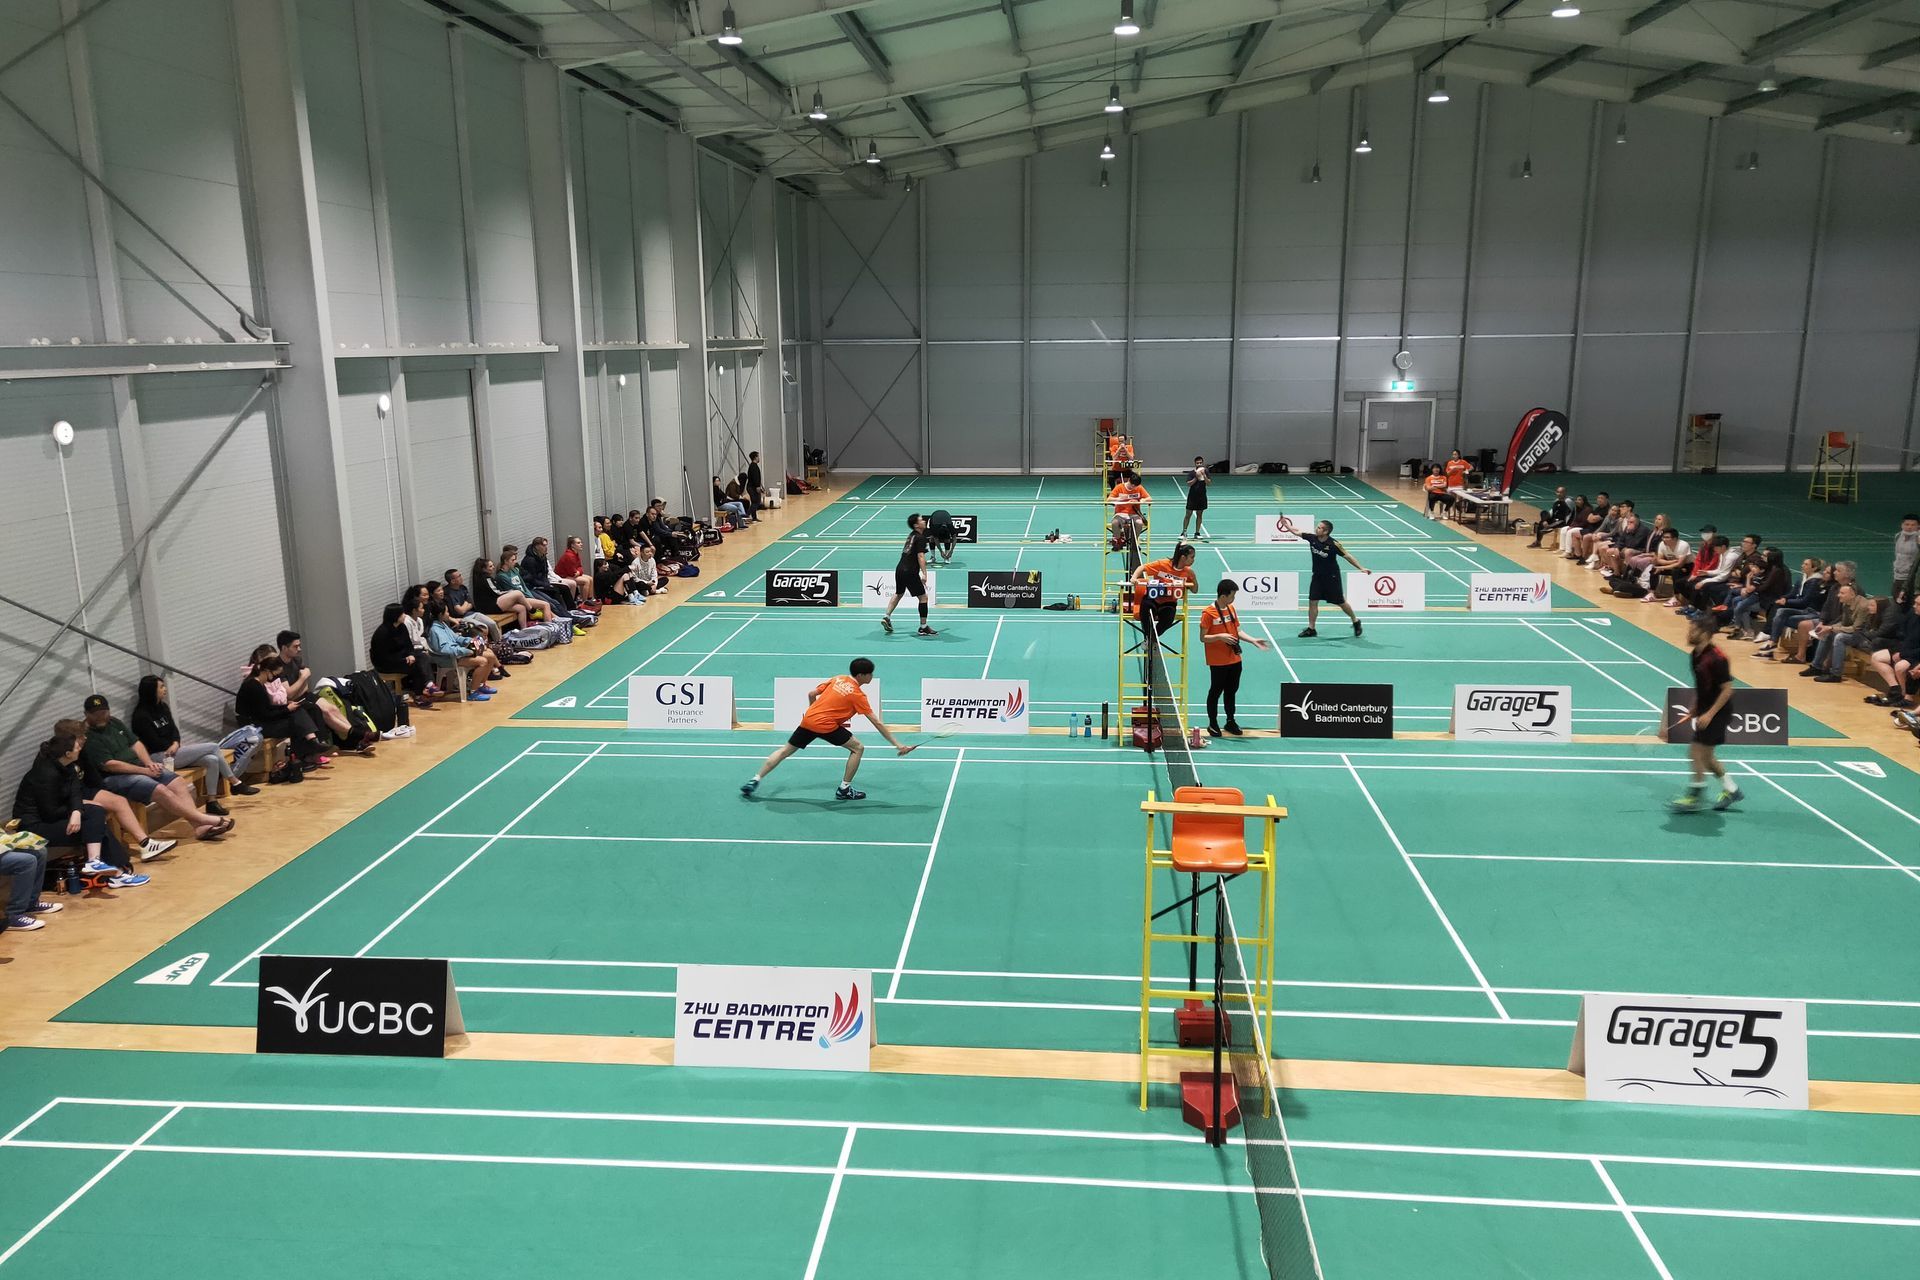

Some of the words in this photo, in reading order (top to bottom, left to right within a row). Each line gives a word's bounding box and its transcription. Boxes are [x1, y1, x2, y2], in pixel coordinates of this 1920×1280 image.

[1518, 420, 1563, 474] Garage5
[773, 573, 831, 598] Garage5
[1243, 576, 1278, 593] GSI
[1479, 593, 1528, 601] CENTRE
[655, 682, 704, 706] GSI
[926, 698, 946, 706] ZHU
[949, 699, 1006, 707] BADMINTON
[931, 707, 998, 719] CENTRE
[1311, 703, 1339, 712] United
[1340, 703, 1388, 714] Canterbury
[1315, 714, 1361, 723] Badminton
[1363, 715, 1383, 723] Club
[1466, 690, 1559, 727] Garage5
[1726, 713, 1781, 734] CBC
[165, 957, 202, 982] BWF
[319, 1001, 434, 1036] UCBC
[683, 1002, 720, 1015] ZHU
[725, 1003, 829, 1018] BADMINTON
[693, 1019, 816, 1042] CENTRE
[1606, 1005, 1783, 1079] Garage5
